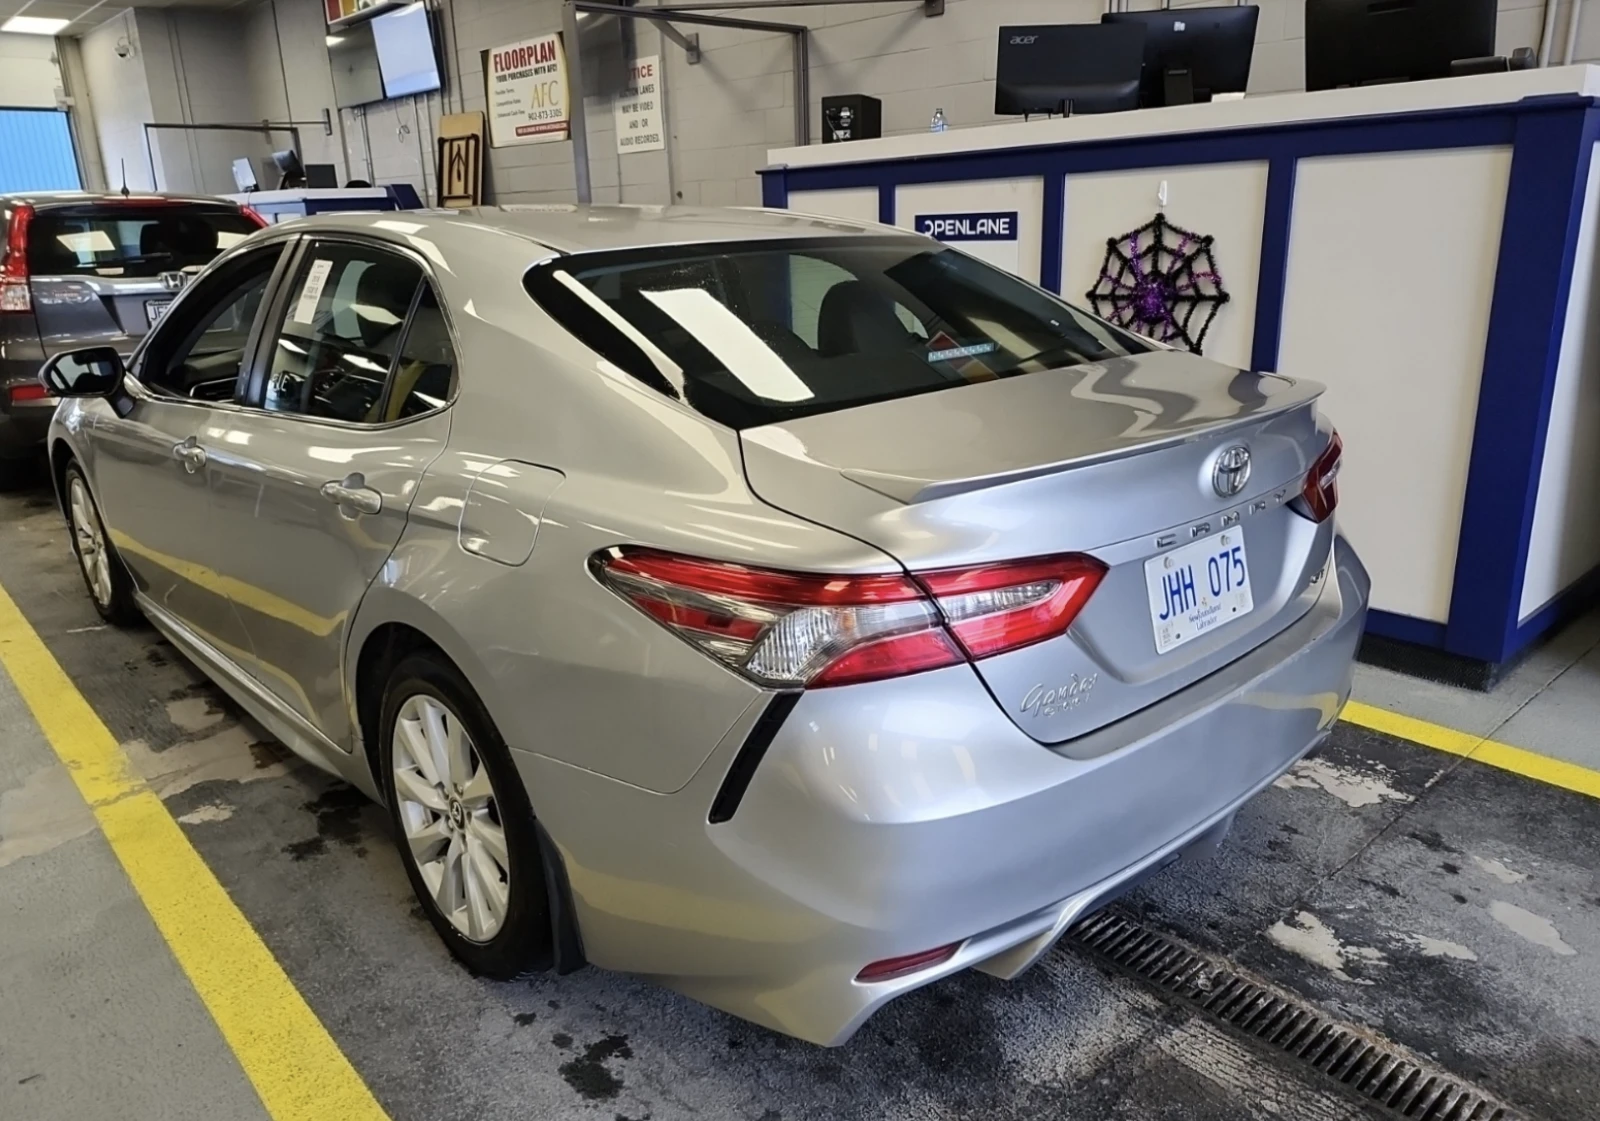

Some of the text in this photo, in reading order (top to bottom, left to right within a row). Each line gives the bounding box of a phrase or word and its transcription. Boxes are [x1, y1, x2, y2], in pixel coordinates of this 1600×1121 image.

[1010, 36, 1038, 44] acer
[493, 40, 556, 73] FLOORPLAN
[508, 69, 534, 81] PURCHASES
[534, 65, 546, 76] WITH
[629, 64, 653, 80] TICE
[531, 80, 559, 110] AFC
[640, 84, 655, 95] LANES
[632, 103, 639, 113] BE
[640, 101, 653, 112] VIDEO
[629, 118, 648, 129] AND OR
[620, 137, 634, 146] AUDIO
[923, 219, 1010, 236] OPENLANE
[1157, 489, 1287, 548] CAMRY
[1159, 546, 1246, 620] JHH 075
